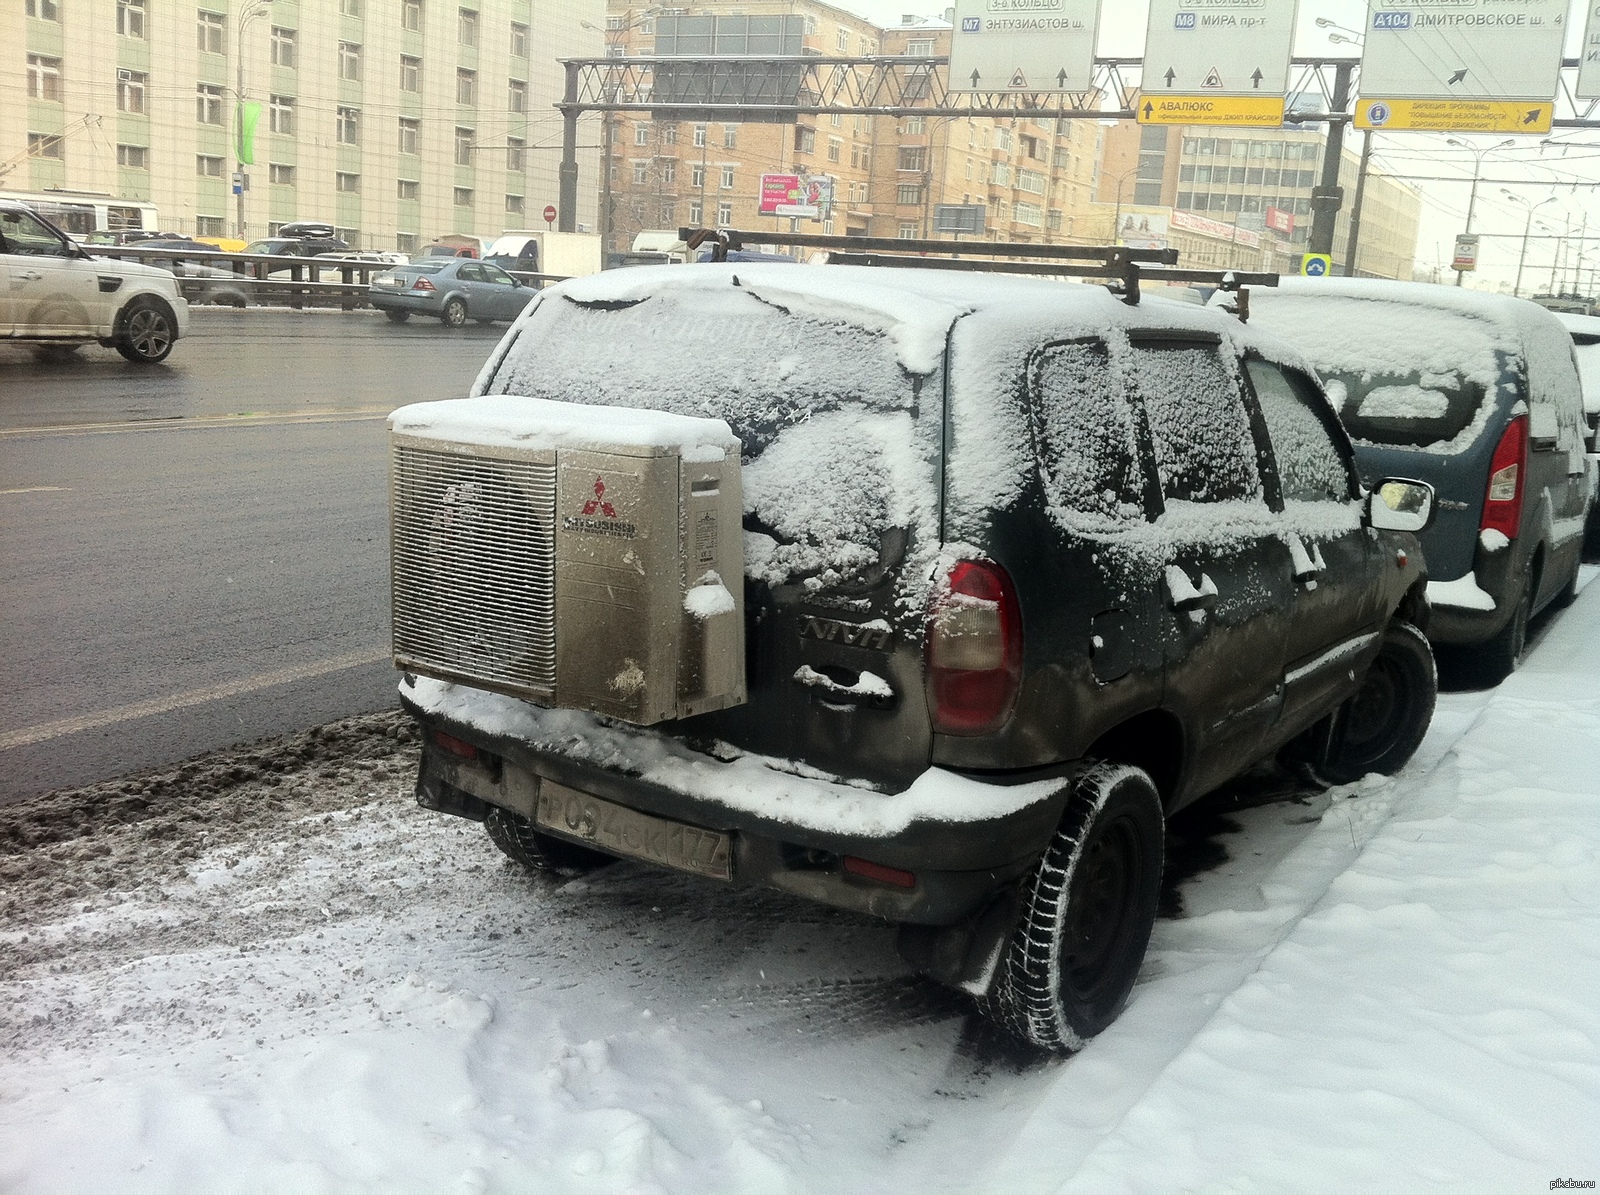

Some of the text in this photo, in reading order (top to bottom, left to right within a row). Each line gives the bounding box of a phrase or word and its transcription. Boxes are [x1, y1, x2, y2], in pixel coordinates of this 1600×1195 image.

[986, 19, 1069, 29] ЭНТУЗИАСТОВ
[1201, 15, 1236, 25] МИРА
[1240, 17, 1267, 27] пр-т
[1374, 14, 1409, 27] А104
[1414, 14, 1526, 27] ДМИТРОВСКОЕ
[1159, 101, 1214, 111] АВАЛЮКС
[800, 619, 891, 650] NIVA
